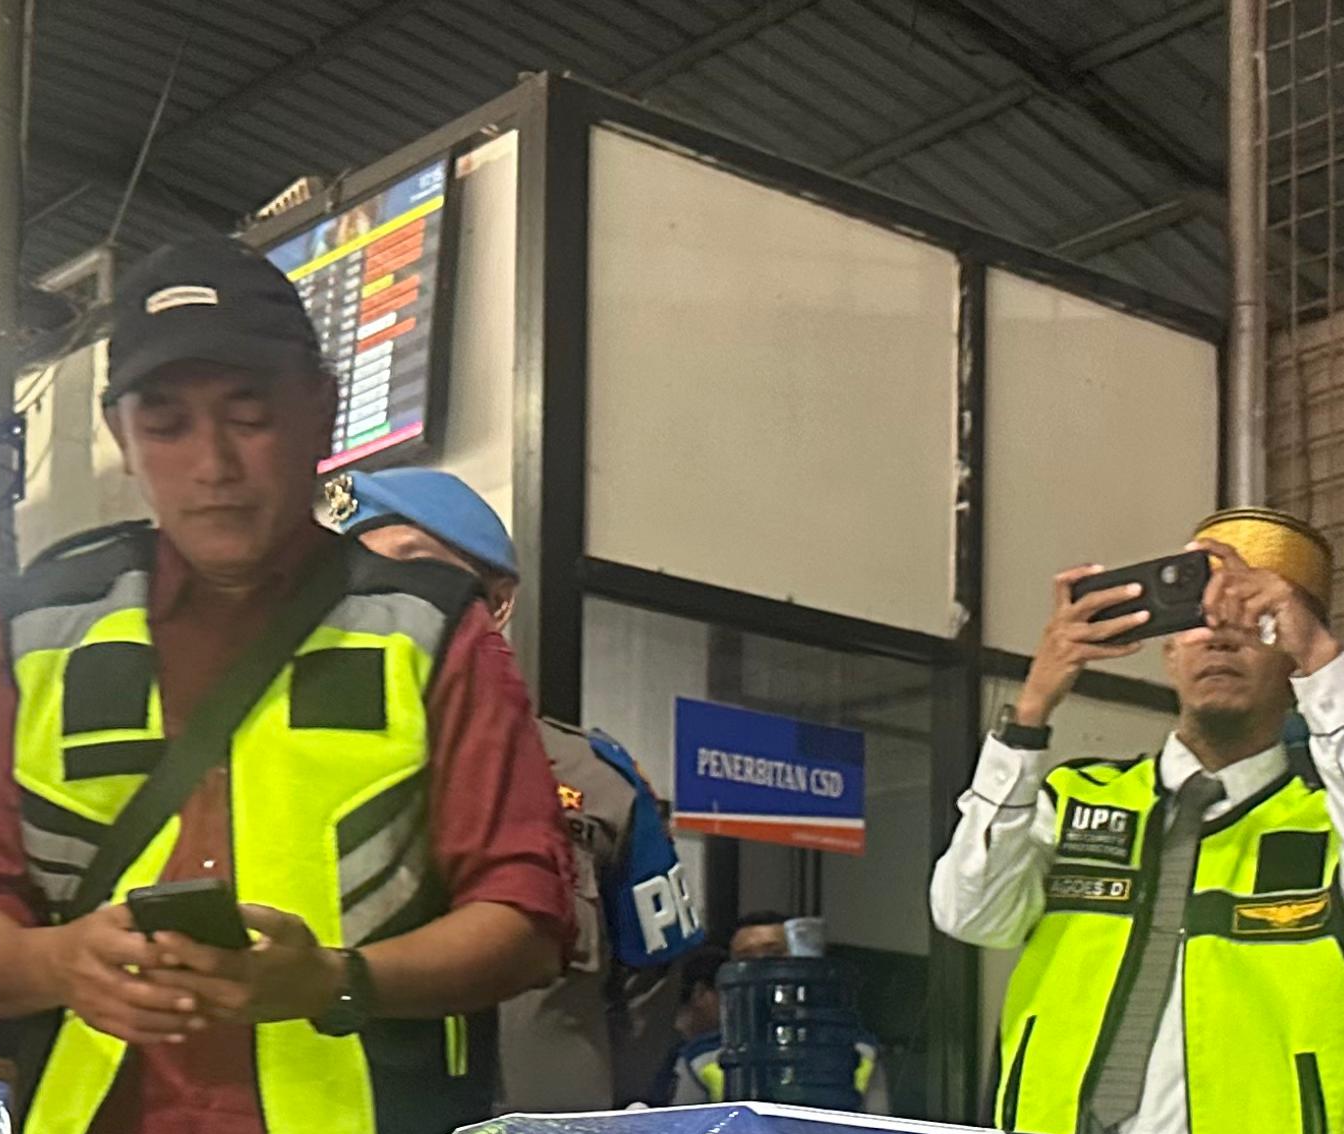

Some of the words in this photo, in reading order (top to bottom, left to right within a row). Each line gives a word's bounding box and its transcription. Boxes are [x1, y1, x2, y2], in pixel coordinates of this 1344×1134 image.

[697, 747, 808, 792] PENERBITAN
[810, 768, 844, 798] CSD
[1071, 806, 1129, 832] UPG
[1109, 881, 1124, 897] D
